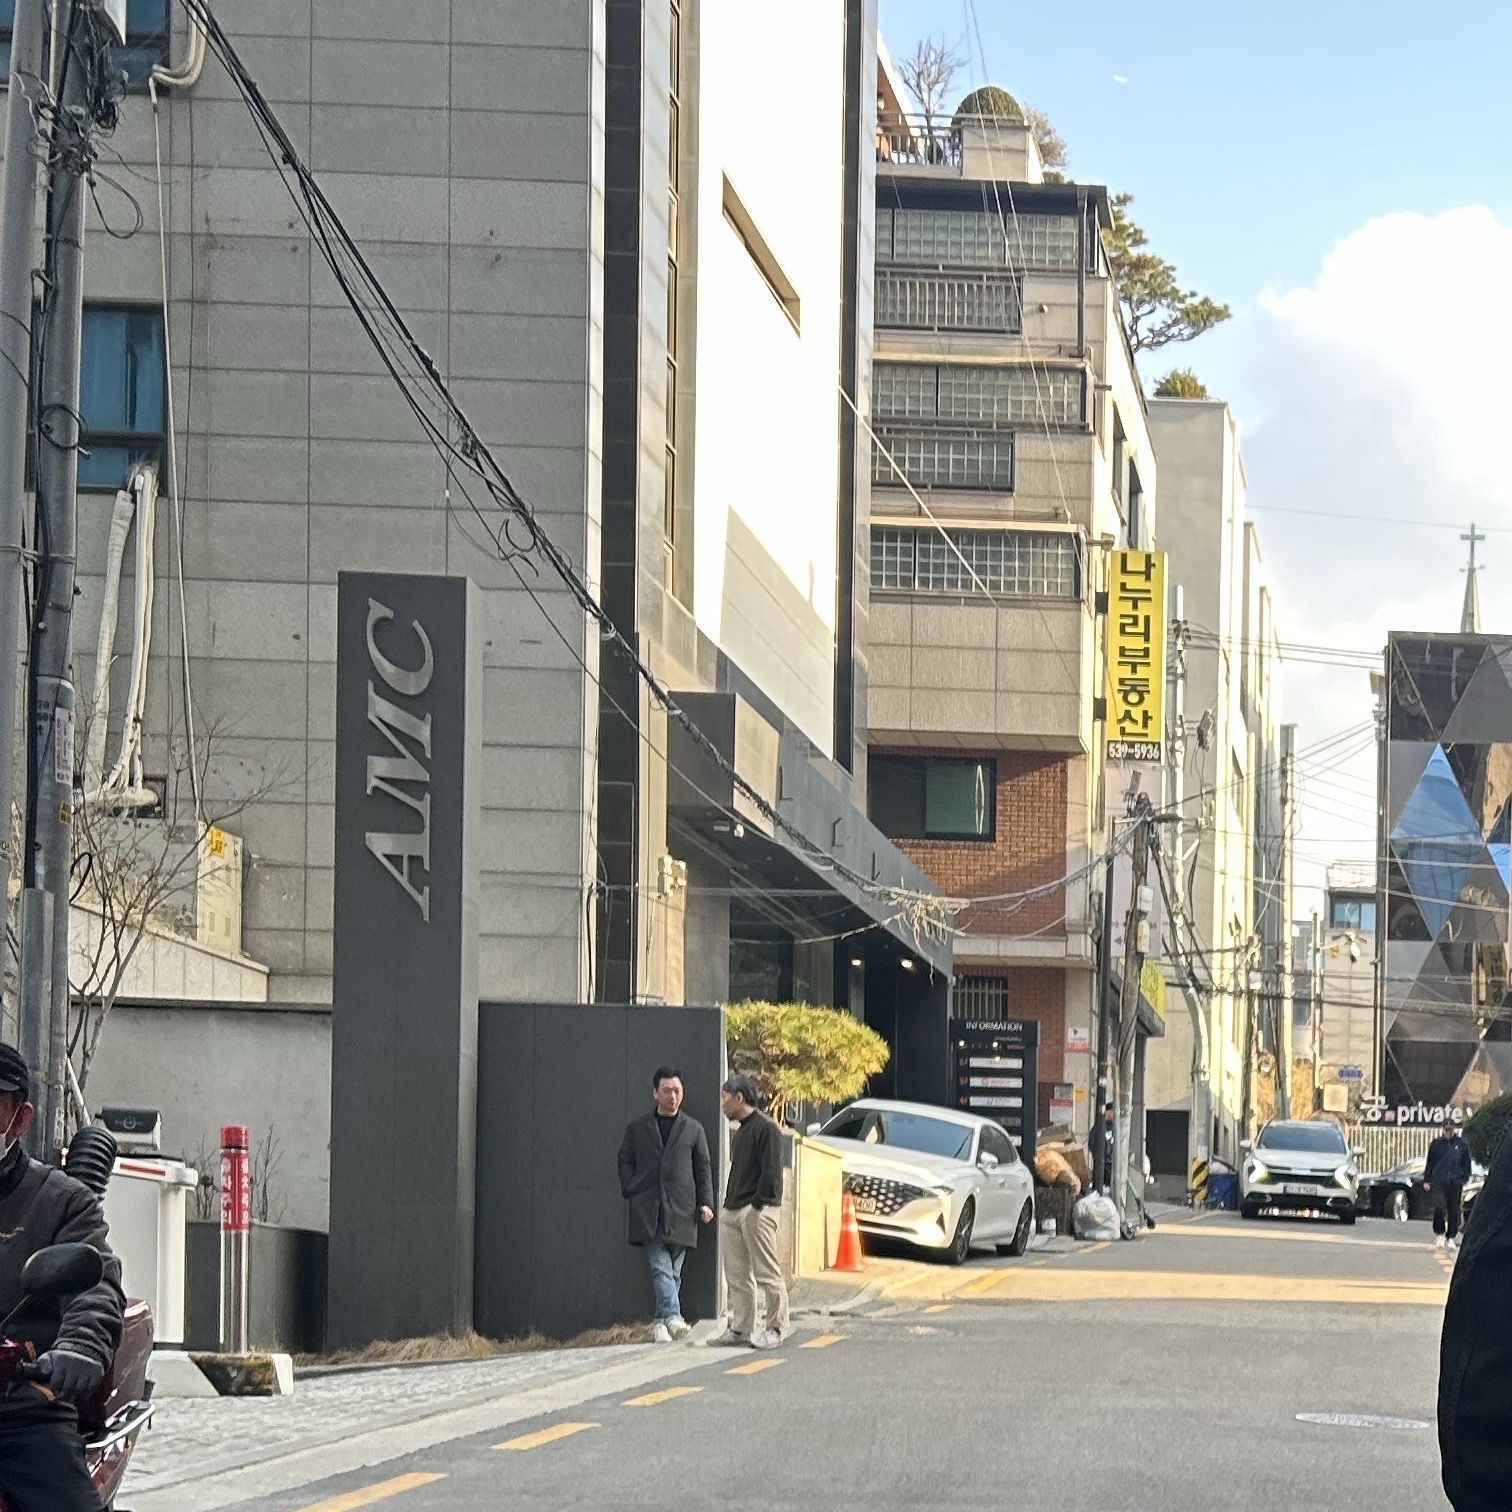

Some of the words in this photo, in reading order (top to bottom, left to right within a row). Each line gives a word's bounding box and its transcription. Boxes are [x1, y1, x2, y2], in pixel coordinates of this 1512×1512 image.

[1117, 552, 1156, 738] 나누리부동산
[365, 597, 435, 923] AMC
[1109, 742, 1160, 760] 539-5936
[1397, 1100, 1464, 1126] private
